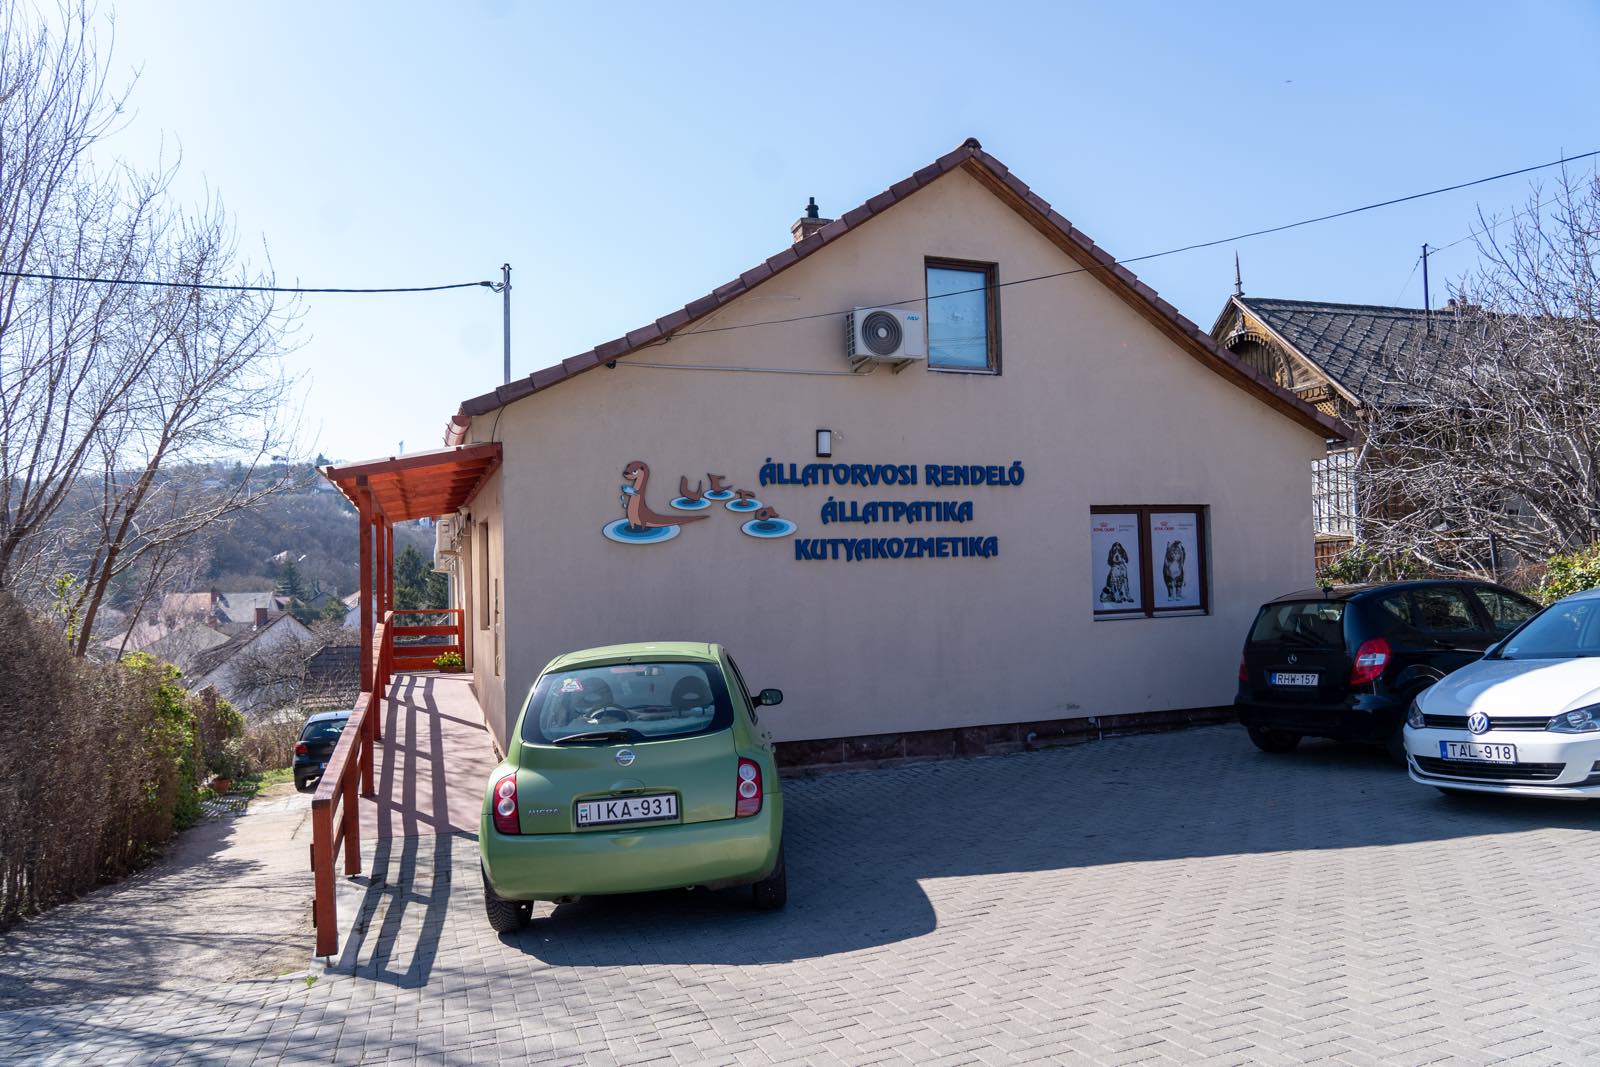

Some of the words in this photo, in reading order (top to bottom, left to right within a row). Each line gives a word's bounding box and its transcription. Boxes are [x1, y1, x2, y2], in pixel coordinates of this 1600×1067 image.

[759, 457, 917, 487] ÁLLATORVOSI
[925, 461, 1025, 487] RENDELŐ
[820, 496, 974, 525] ÁLLATPATIKA
[795, 536, 999, 562] KUTYAKOZMETIKA
[1277, 674, 1317, 685] RHW-157
[1448, 743, 1511, 760] TAL-918
[597, 797, 672, 820] IKA-931
